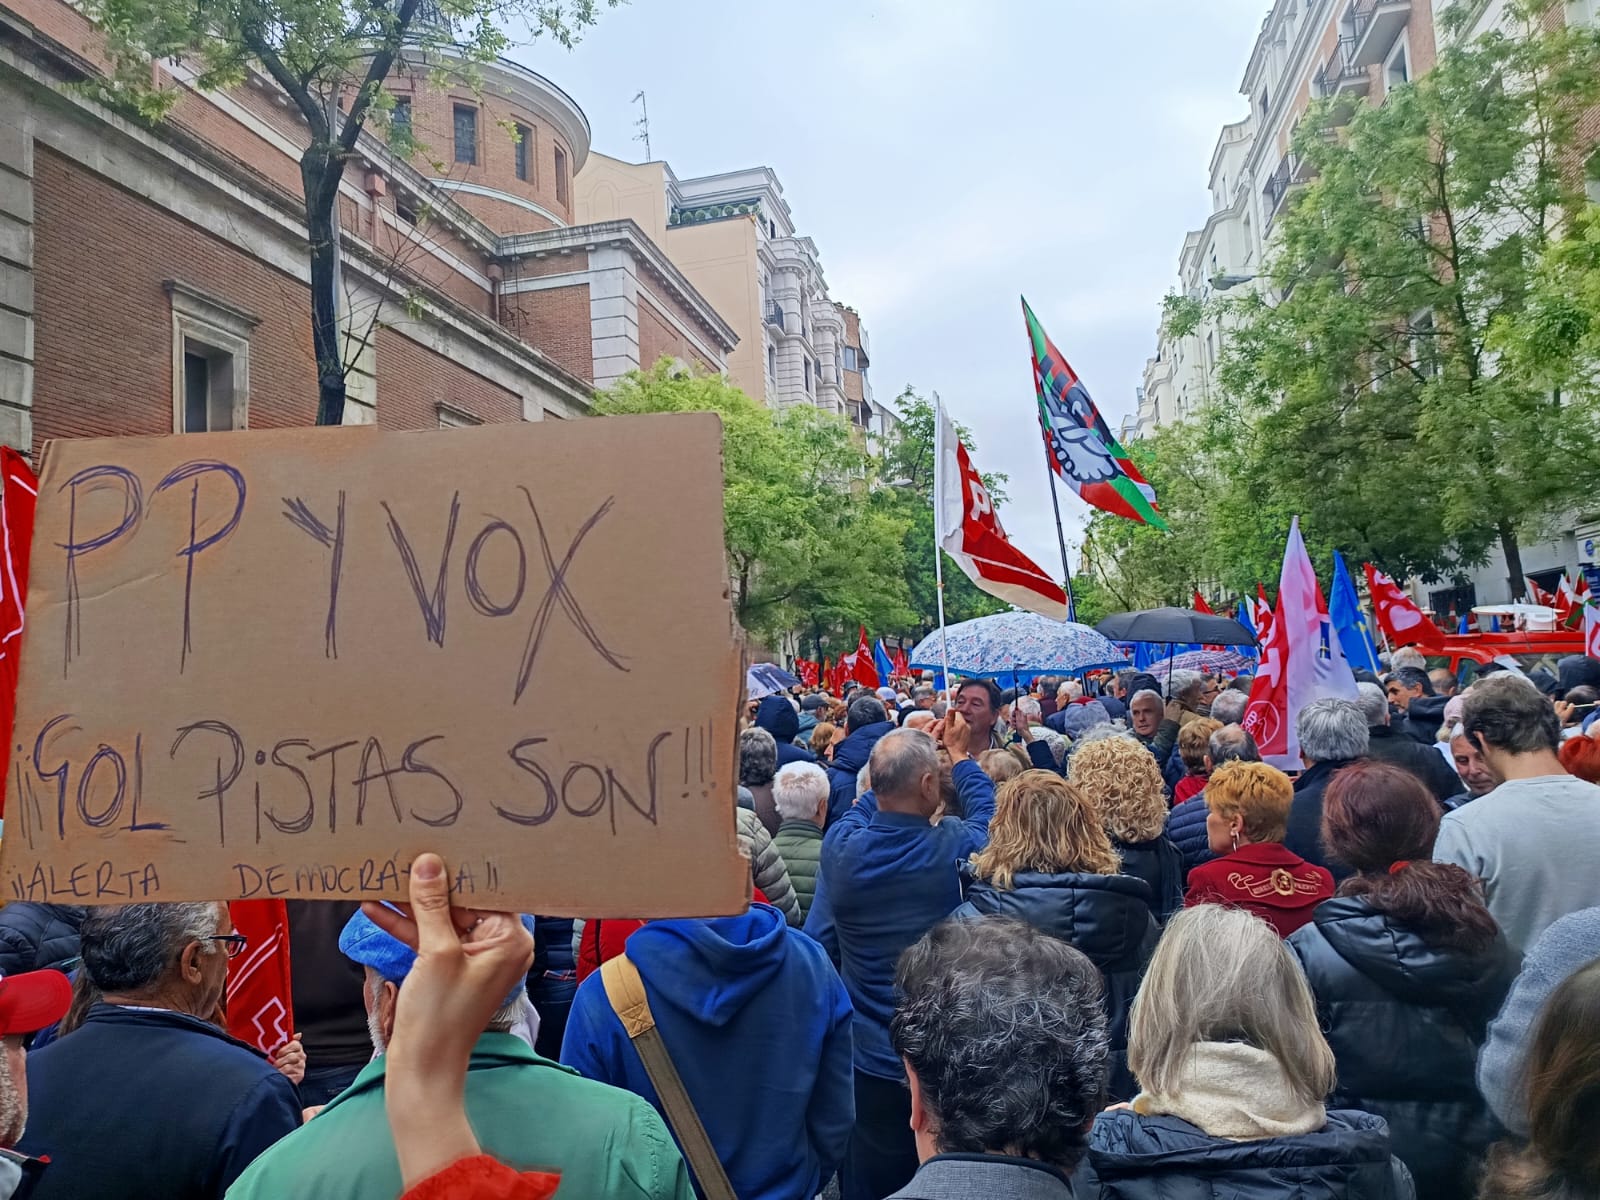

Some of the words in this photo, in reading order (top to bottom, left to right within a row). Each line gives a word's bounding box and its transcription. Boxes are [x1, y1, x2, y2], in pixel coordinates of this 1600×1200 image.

[55, 459, 247, 679] PP
[281, 489, 346, 660] Y
[380, 485, 632, 704] VOX
